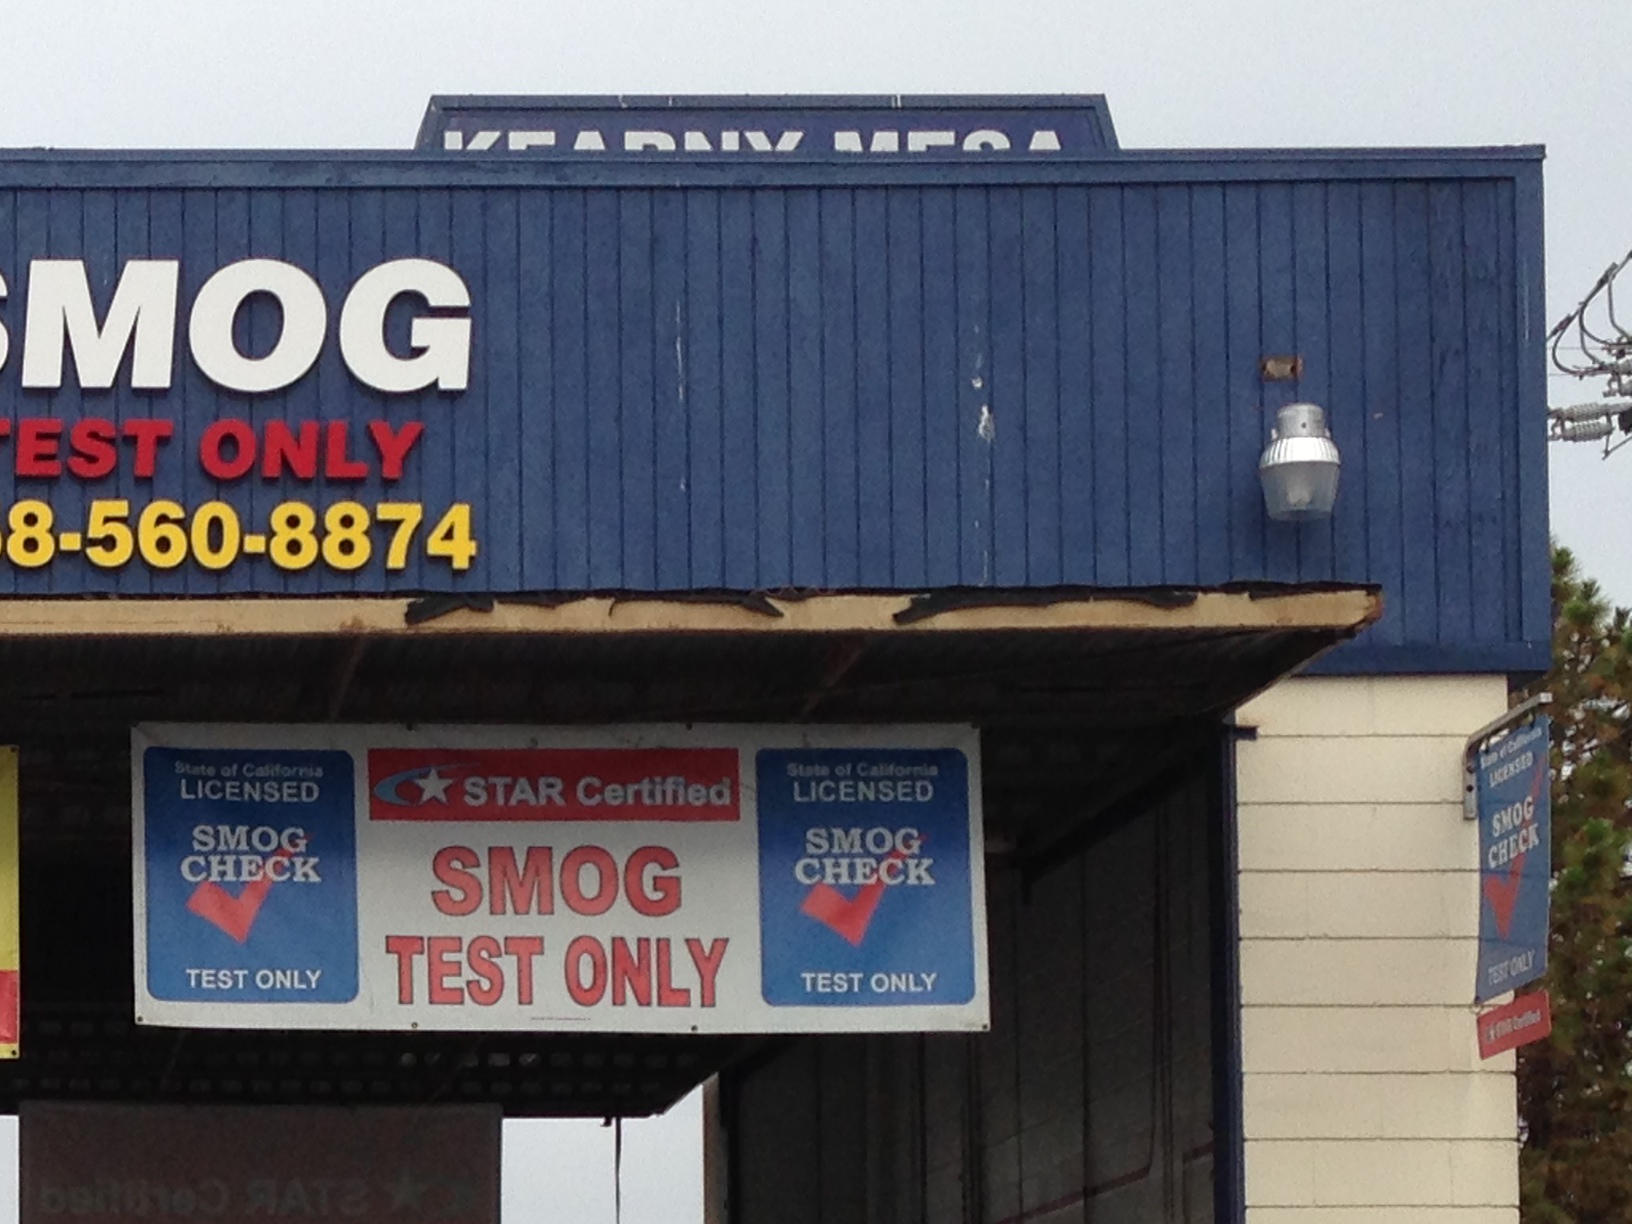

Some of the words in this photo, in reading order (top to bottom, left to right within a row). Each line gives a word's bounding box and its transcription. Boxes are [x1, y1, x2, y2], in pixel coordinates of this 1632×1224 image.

[199, 420, 424, 480] ONLY
[174, 760, 216, 777] State
[220, 762, 238, 777] of
[242, 763, 324, 779] California
[786, 762, 831, 778] State
[834, 762, 852, 777] of
[856, 761, 939, 778] California
[180, 779, 320, 802] LICENSED
[464, 775, 565, 807] STAR
[575, 774, 732, 808] Certified
[793, 779, 935, 803] LICENSED
[1492, 796, 1535, 838] SMOG
[192, 825, 309, 852] SMOG
[805, 827, 922, 855] SMOG
[1487, 823, 1541, 869] CHECK
[180, 855, 322, 883] CHECK
[431, 845, 682, 917] SMOG
[794, 857, 936, 886] CHECK
[185, 968, 249, 989] TEST
[255, 970, 322, 990] ONLY
[385, 935, 546, 1007] TEST
[563, 936, 730, 1008] ONLY
[800, 972, 864, 993] TEST
[870, 973, 939, 994] ONLY
